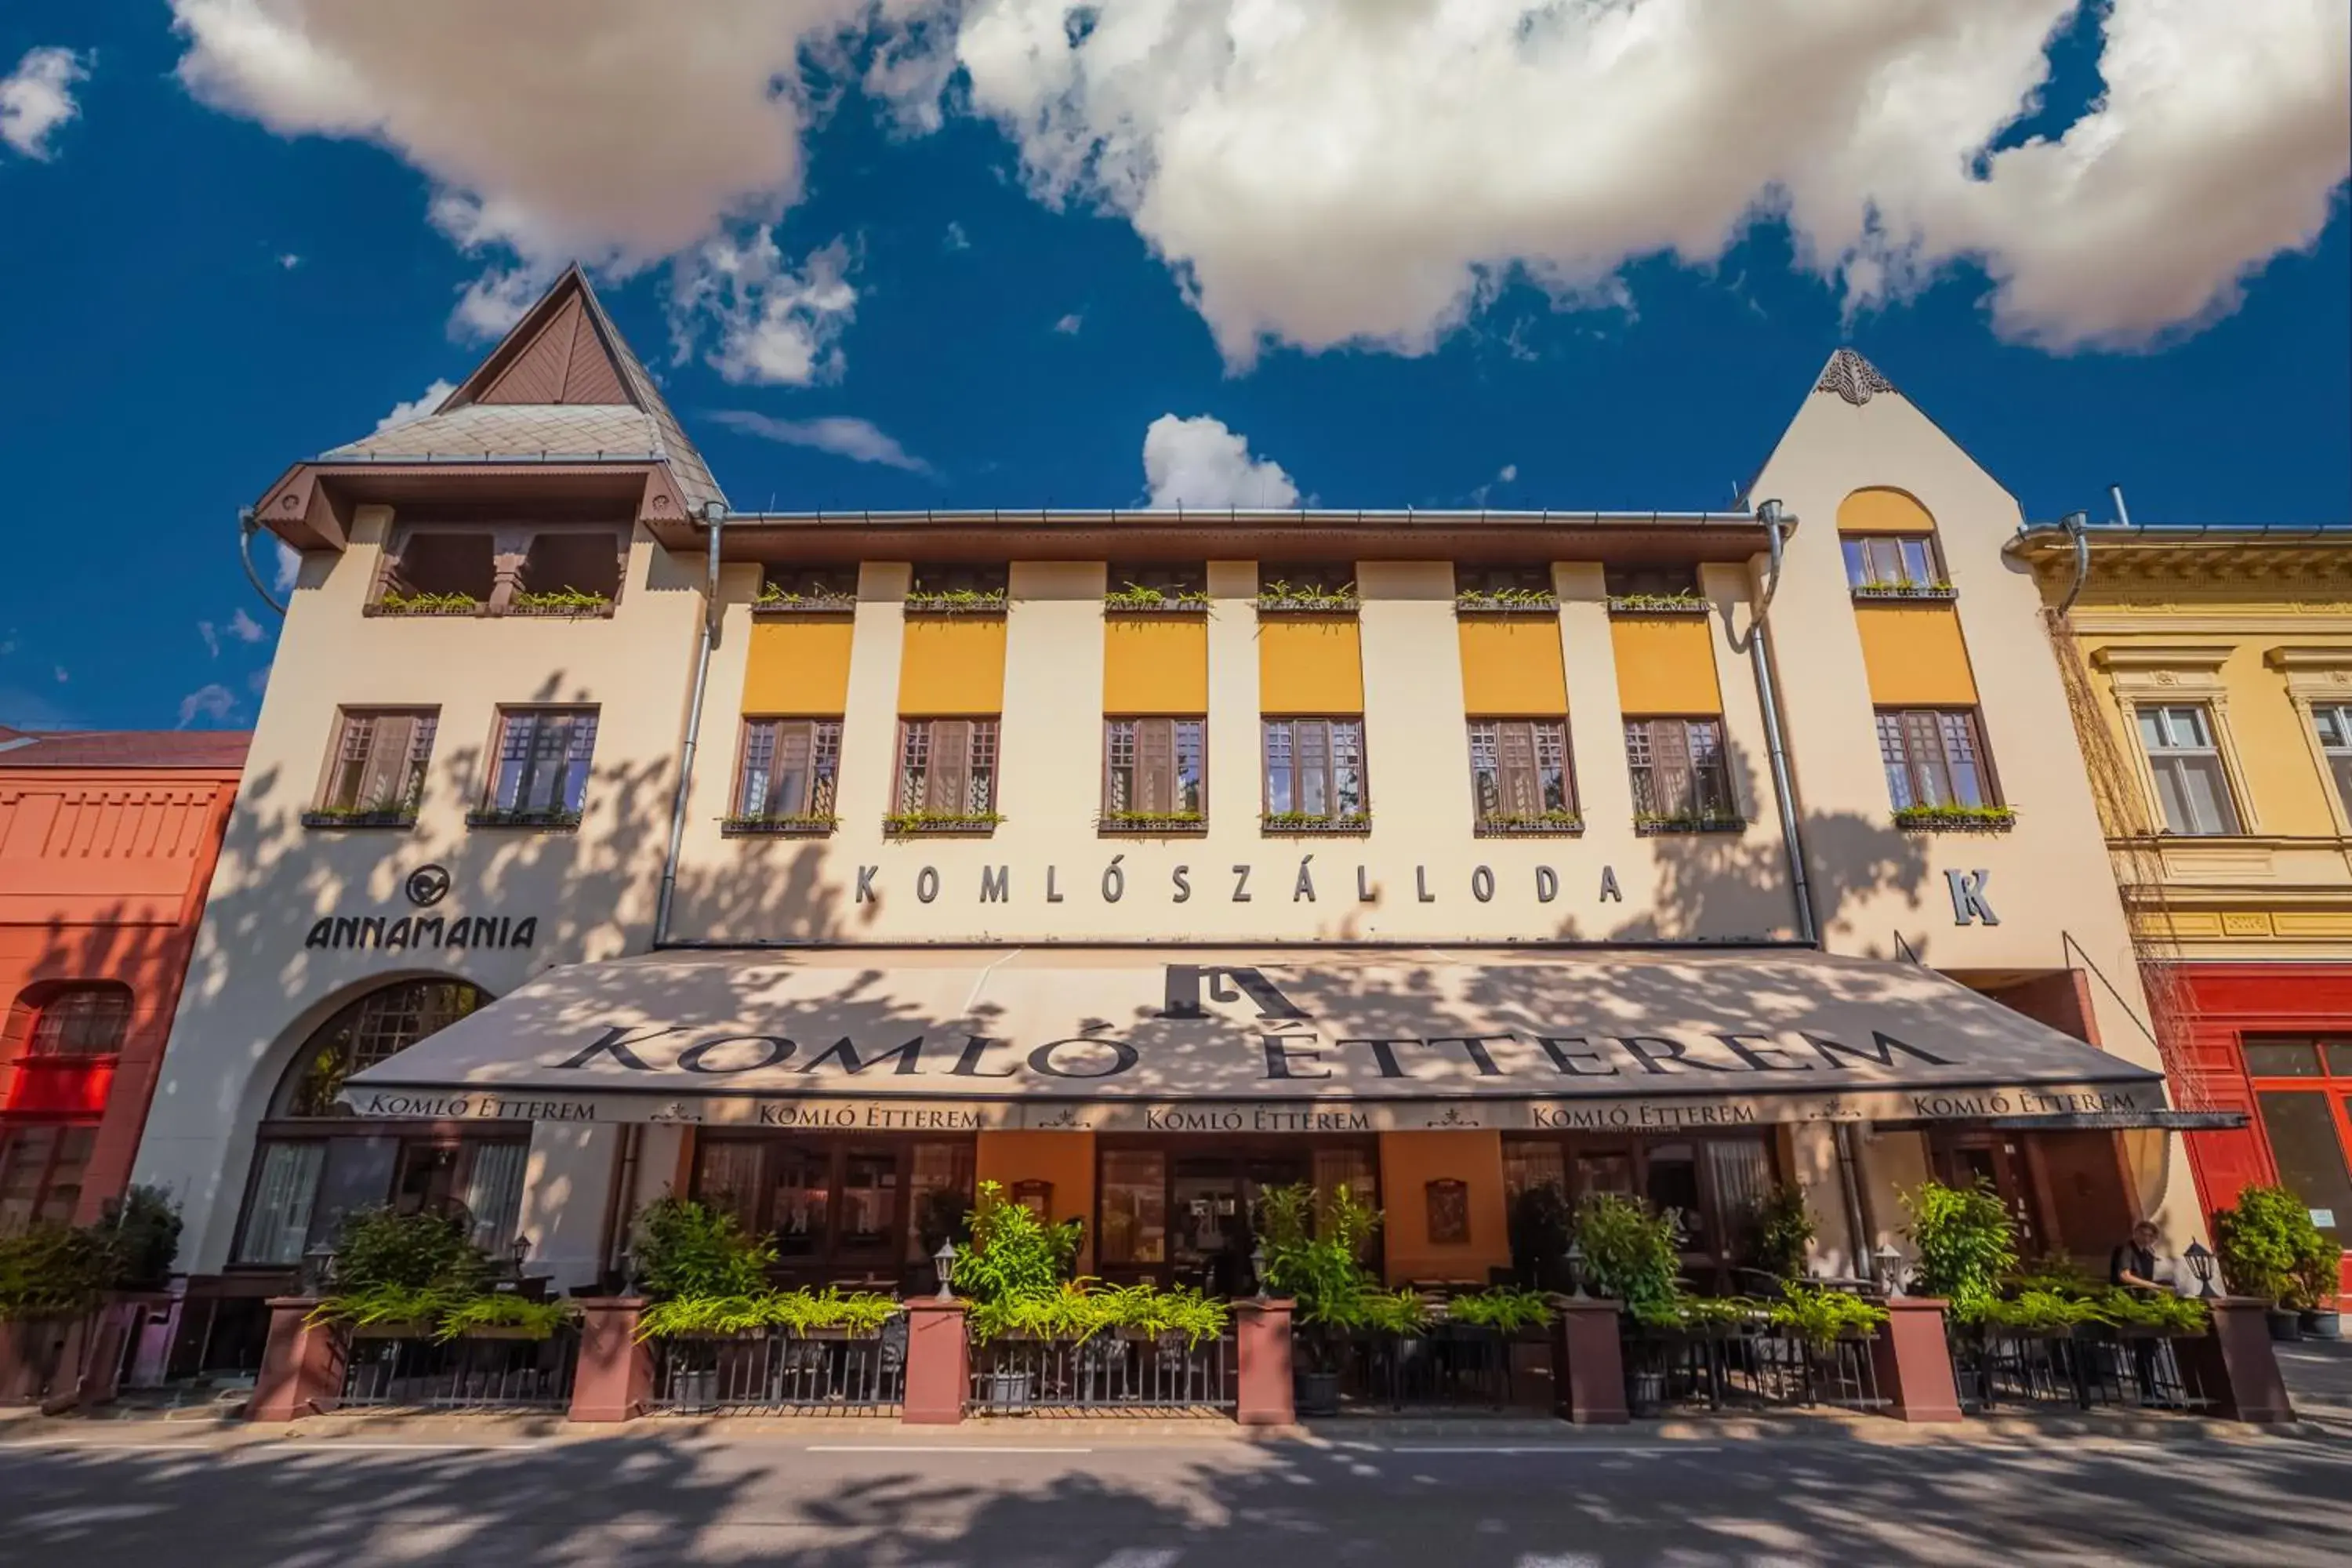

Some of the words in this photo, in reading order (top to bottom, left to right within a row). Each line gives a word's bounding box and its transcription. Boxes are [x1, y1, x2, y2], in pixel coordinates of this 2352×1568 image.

[1943, 869, 2001, 926] K
[305, 916, 538, 949] ANNAMANIA
[543, 1022, 1141, 1079] KOMLÓ
[1256, 1022, 1966, 1080] ÉTTEREM
[368, 1094, 468, 1116] KOMLÓ
[477, 1093, 596, 1120] ÉTTEREM
[759, 1104, 856, 1127] KOMLÓ
[866, 1102, 982, 1129] ÉTTEREM
[1639, 1101, 1755, 1126] ÉTTEREM
[1914, 1091, 2010, 1116] KOMLÓ
[1145, 1107, 1243, 1131] KOMLÓ
[1254, 1105, 1370, 1131] ÉTTEREM
